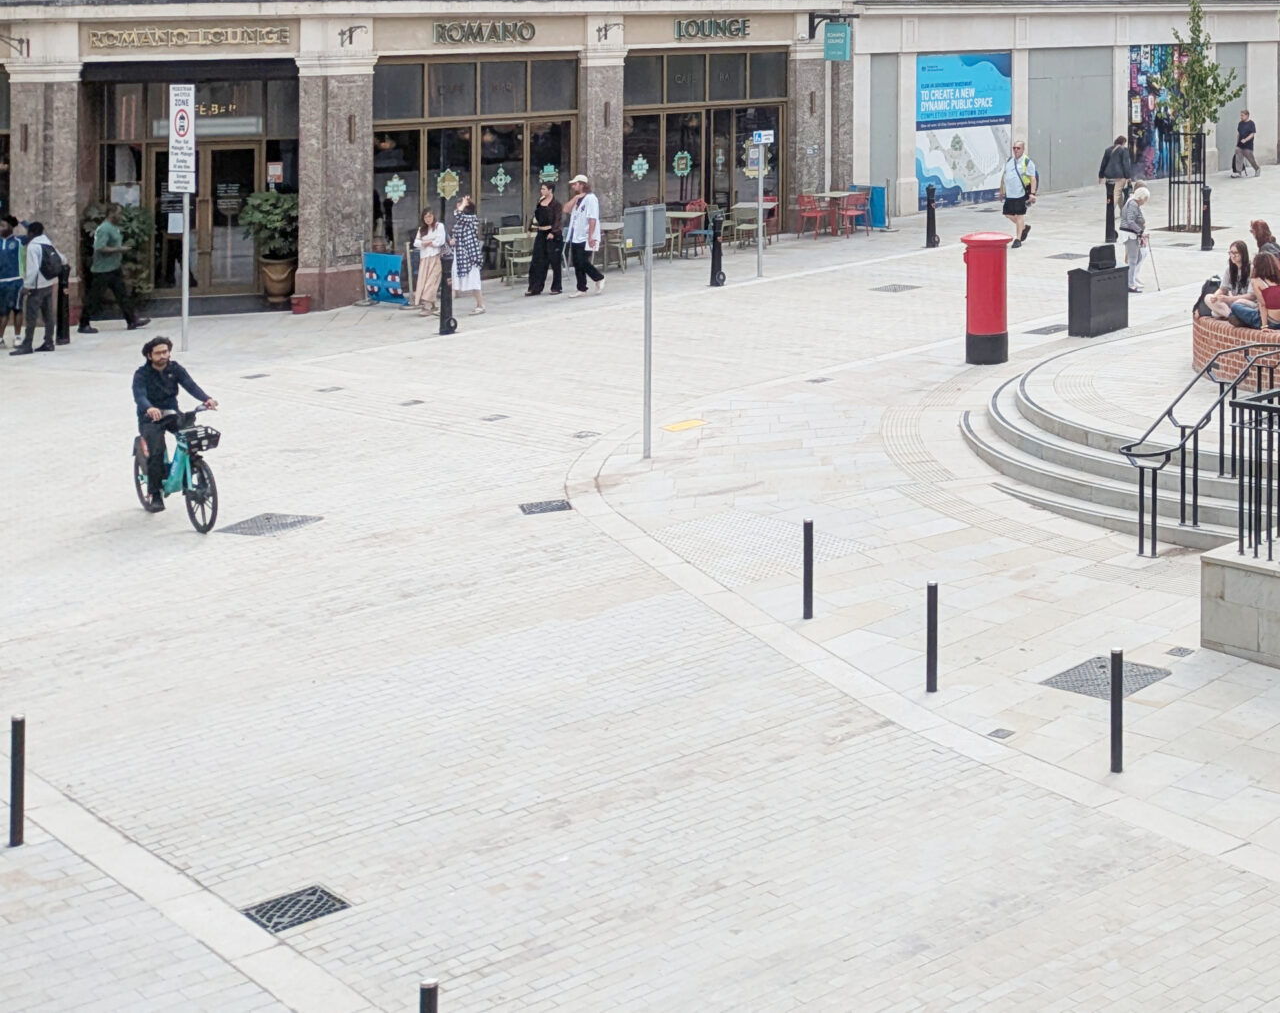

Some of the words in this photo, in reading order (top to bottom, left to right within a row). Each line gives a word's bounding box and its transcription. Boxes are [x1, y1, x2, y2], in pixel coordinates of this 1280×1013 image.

[90, 28, 189, 48] ROMANO
[199, 26, 290, 46] LOUNGE
[432, 20, 536, 44] ROMANO
[674, 18, 750, 40] LOUNGE
[174, 98, 190, 107] ZONE
[920, 90, 929, 101] TO
[930, 88, 954, 100] CREATE
[955, 88, 960, 98] A
[960, 87, 976, 98] NEW
[920, 100, 950, 112] DYNAMIC
[950, 98, 973, 110] PUBLIC
[974, 97, 993, 108] SPACE
